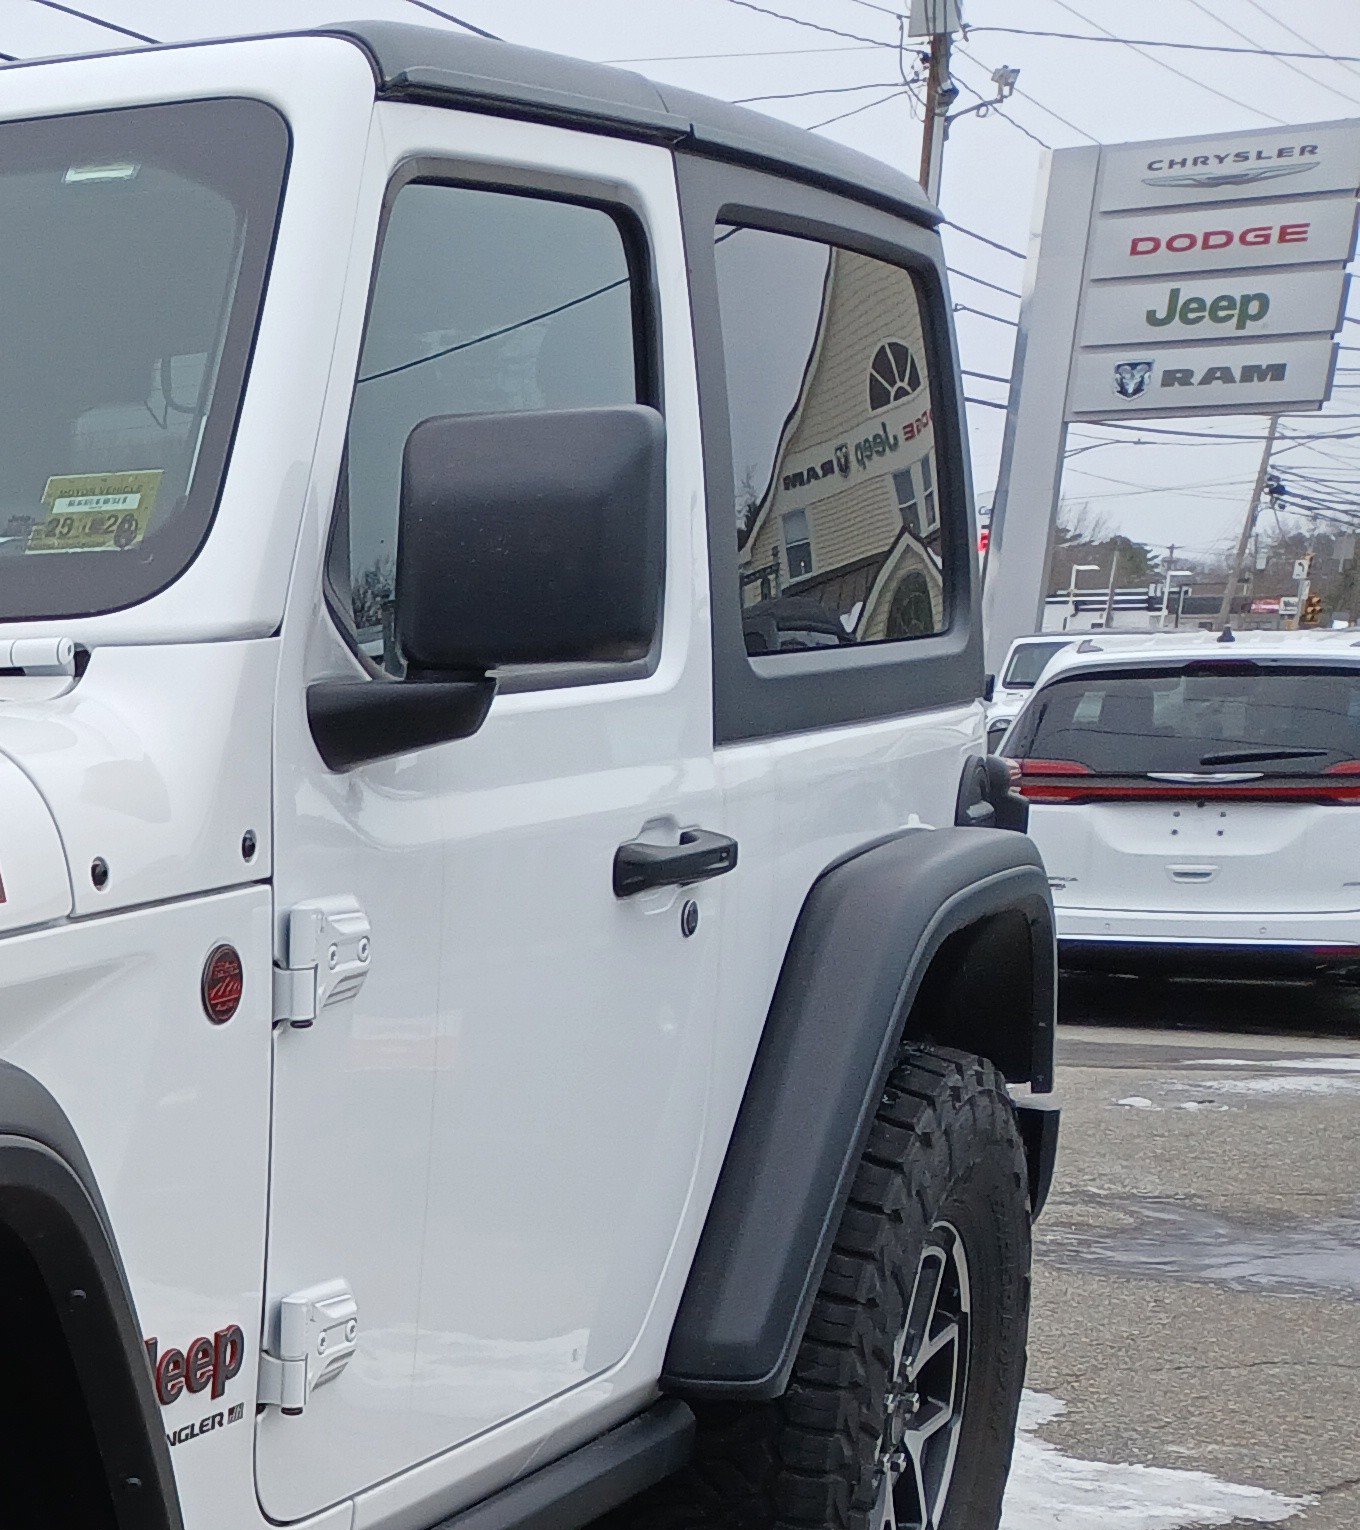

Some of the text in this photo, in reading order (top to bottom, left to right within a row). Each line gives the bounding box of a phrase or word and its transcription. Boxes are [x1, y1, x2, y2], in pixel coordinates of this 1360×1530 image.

[1146, 143, 1319, 172] CHRYSLER
[1130, 222, 1311, 256] DODGE
[1145, 287, 1270, 331] Jeep
[1160, 362, 1288, 388] RAM
[166, 1411, 224, 1446] NGLER
